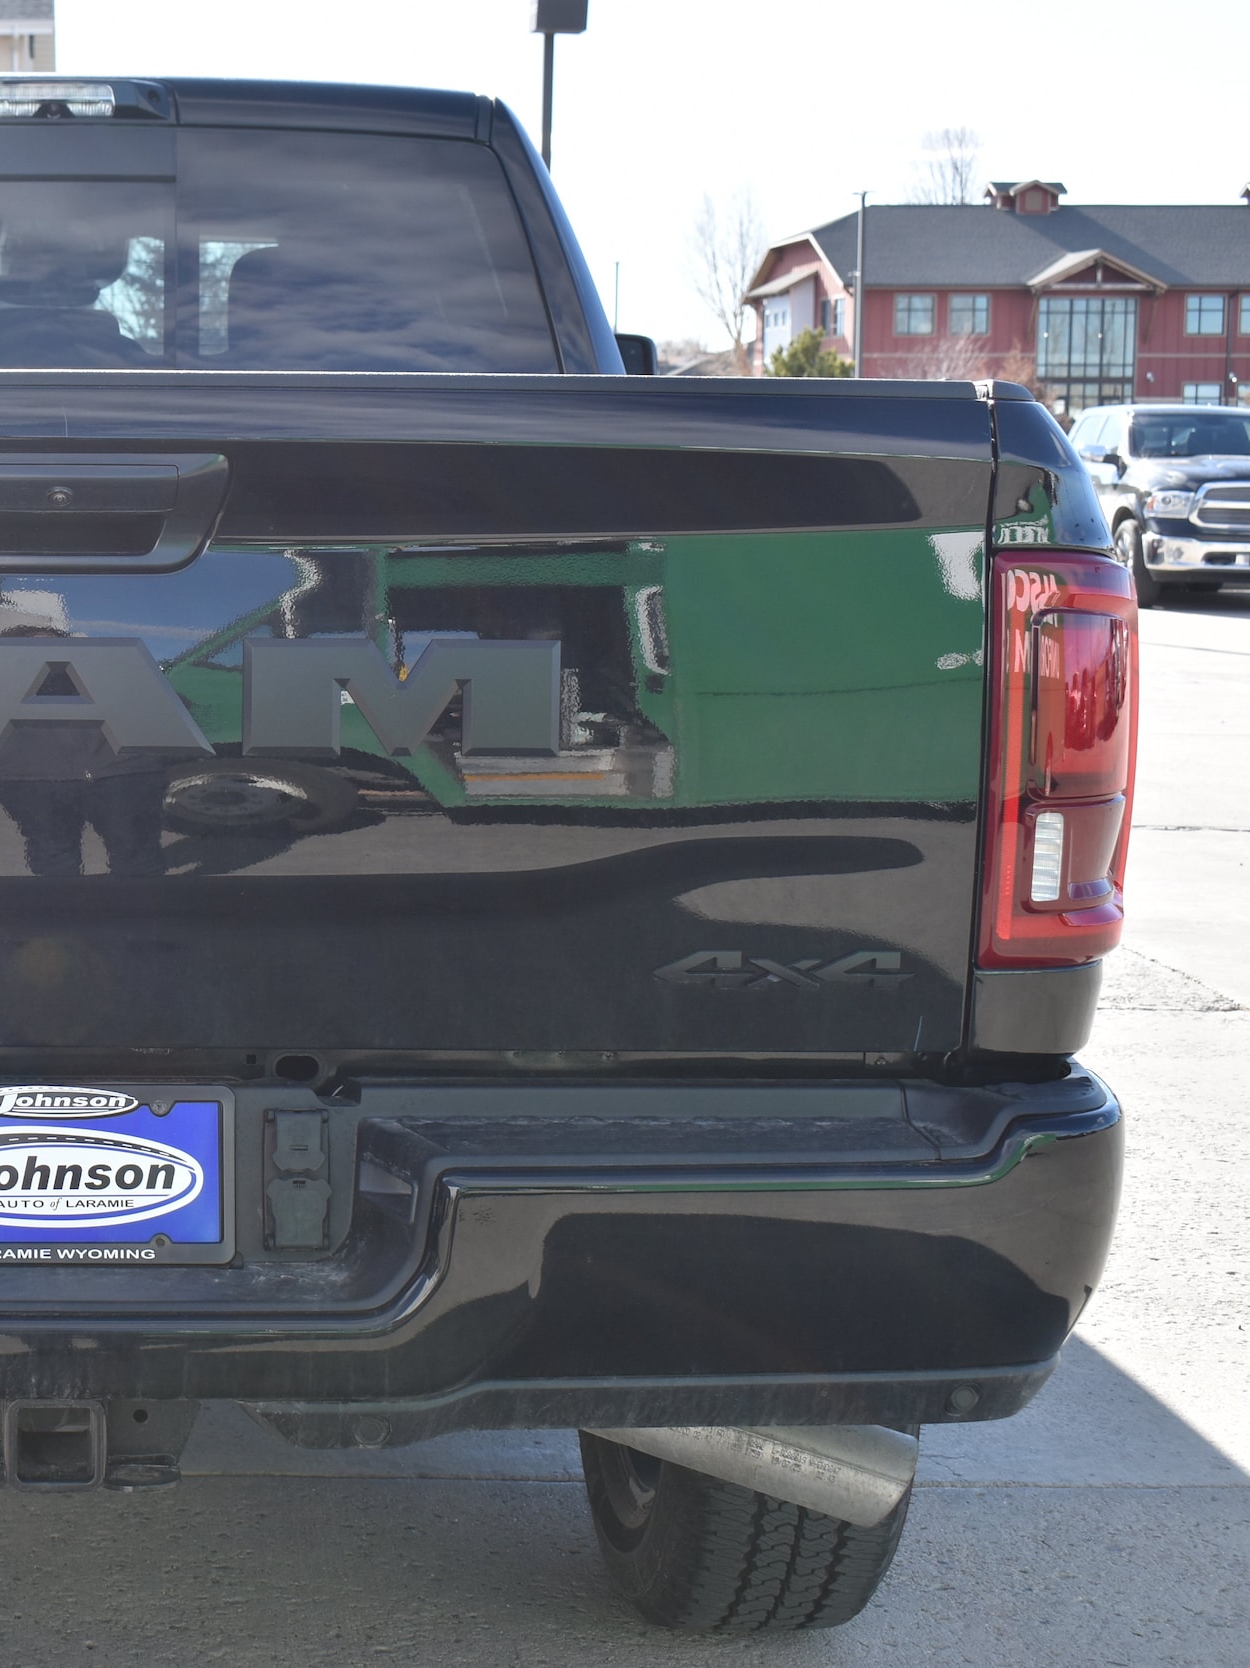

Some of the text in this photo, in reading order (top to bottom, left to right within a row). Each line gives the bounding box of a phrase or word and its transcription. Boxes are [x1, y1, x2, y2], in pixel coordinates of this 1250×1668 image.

[49, 1197, 62, 1212] of
[65, 1199, 135, 1208] LARAMIE
[56, 1248, 157, 1260] WYOMING
